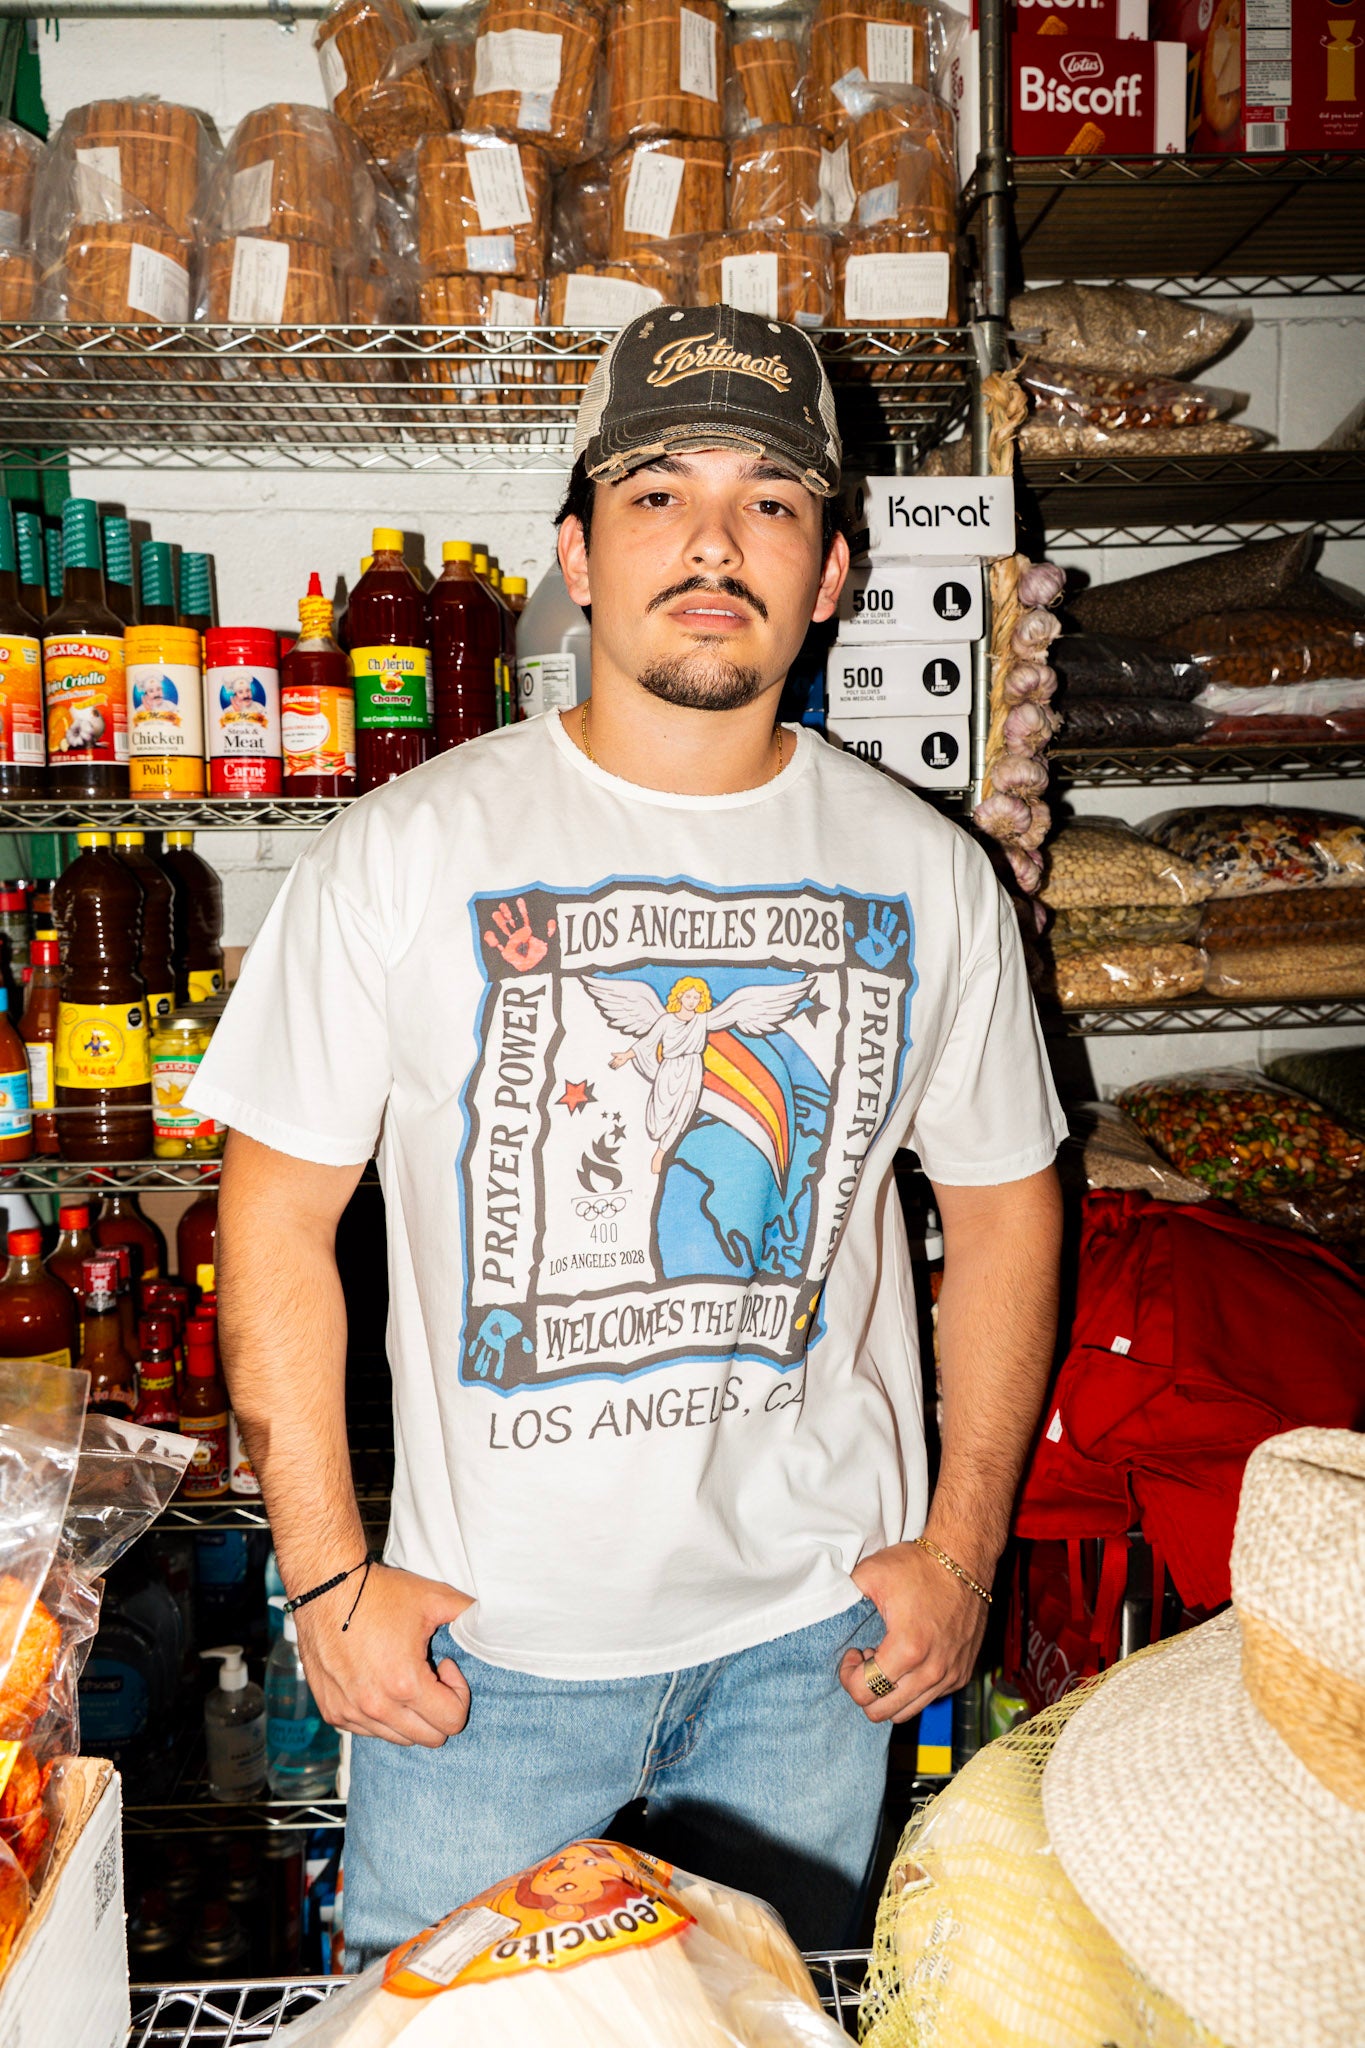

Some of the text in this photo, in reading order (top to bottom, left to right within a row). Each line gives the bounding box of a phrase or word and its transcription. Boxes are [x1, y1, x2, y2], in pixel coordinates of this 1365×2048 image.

[1067, 56, 1099, 74] Lotus
[1020, 66, 1143, 117] Biscoff
[647, 332, 792, 384] Fortunate
[853, 590, 894, 612] 500
[945, 586, 959, 610] L
[942, 608, 962, 617] LARGE
[62, 672, 106, 690] Criollo
[843, 667, 883, 688] 500
[934, 662, 949, 686] L
[370, 693, 413, 707] Chamoy
[931, 685, 951, 693] LARGE
[132, 731, 184, 746] Chicken
[225, 736, 265, 748] Meat
[933, 736, 947, 759] L
[842, 741, 882, 762] 500
[930, 757, 950, 766] LARGE
[143, 764, 172, 776] Pollo
[223, 763, 266, 777] Carne
[564, 904, 840, 956] LOS ANGELES 2028
[847, 981, 891, 1138] PRAYER
[482, 984, 547, 1289] PRAYER POWER
[589, 1222, 618, 1244] 400
[550, 1249, 645, 1276] LOS ANGELES 2028
[545, 1299, 685, 1361] WELCOMES
[691, 1298, 738, 1336] THE
[490, 1404, 574, 1449] LOS
[588, 1375, 750, 1440] ANGELS,
[495, 1900, 663, 1964] eoncito
